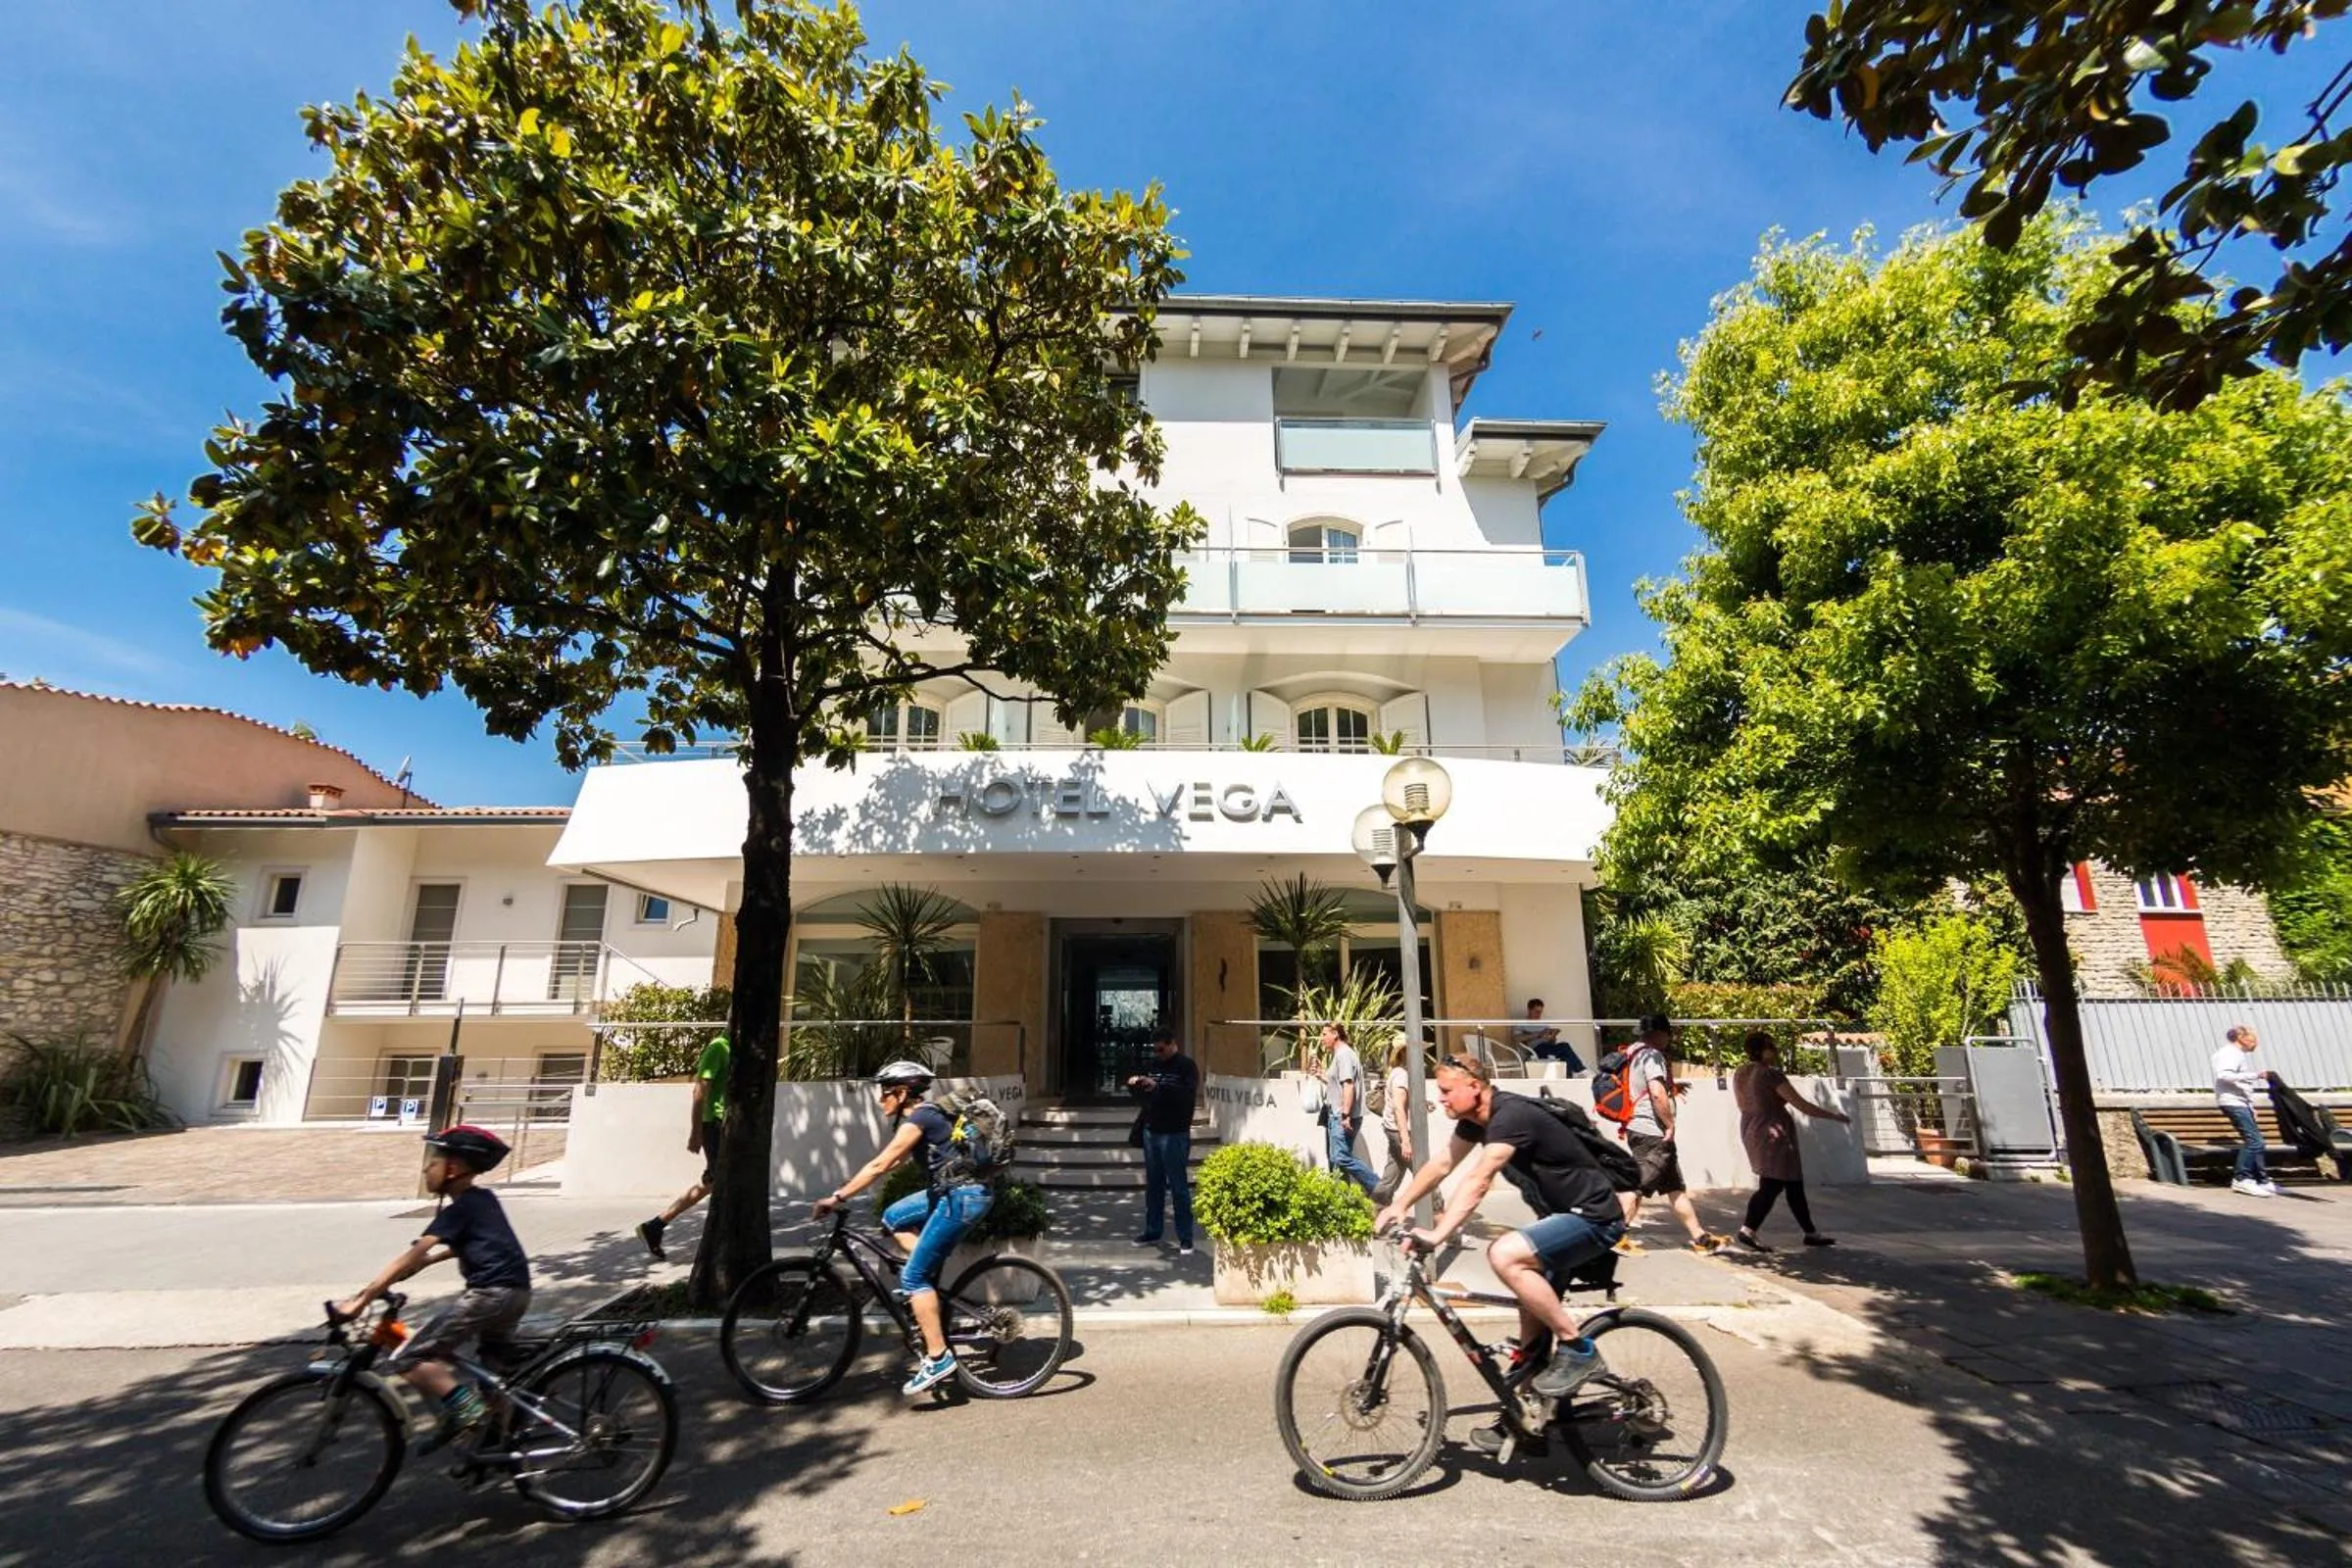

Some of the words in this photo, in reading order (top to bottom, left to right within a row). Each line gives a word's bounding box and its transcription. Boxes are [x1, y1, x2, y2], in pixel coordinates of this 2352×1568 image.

[933, 777, 1110, 816] HOTEL
[1146, 779, 1303, 823] VEGA
[998, 1086, 1022, 1101] VEGA
[1235, 1090, 1277, 1107] VEGA
